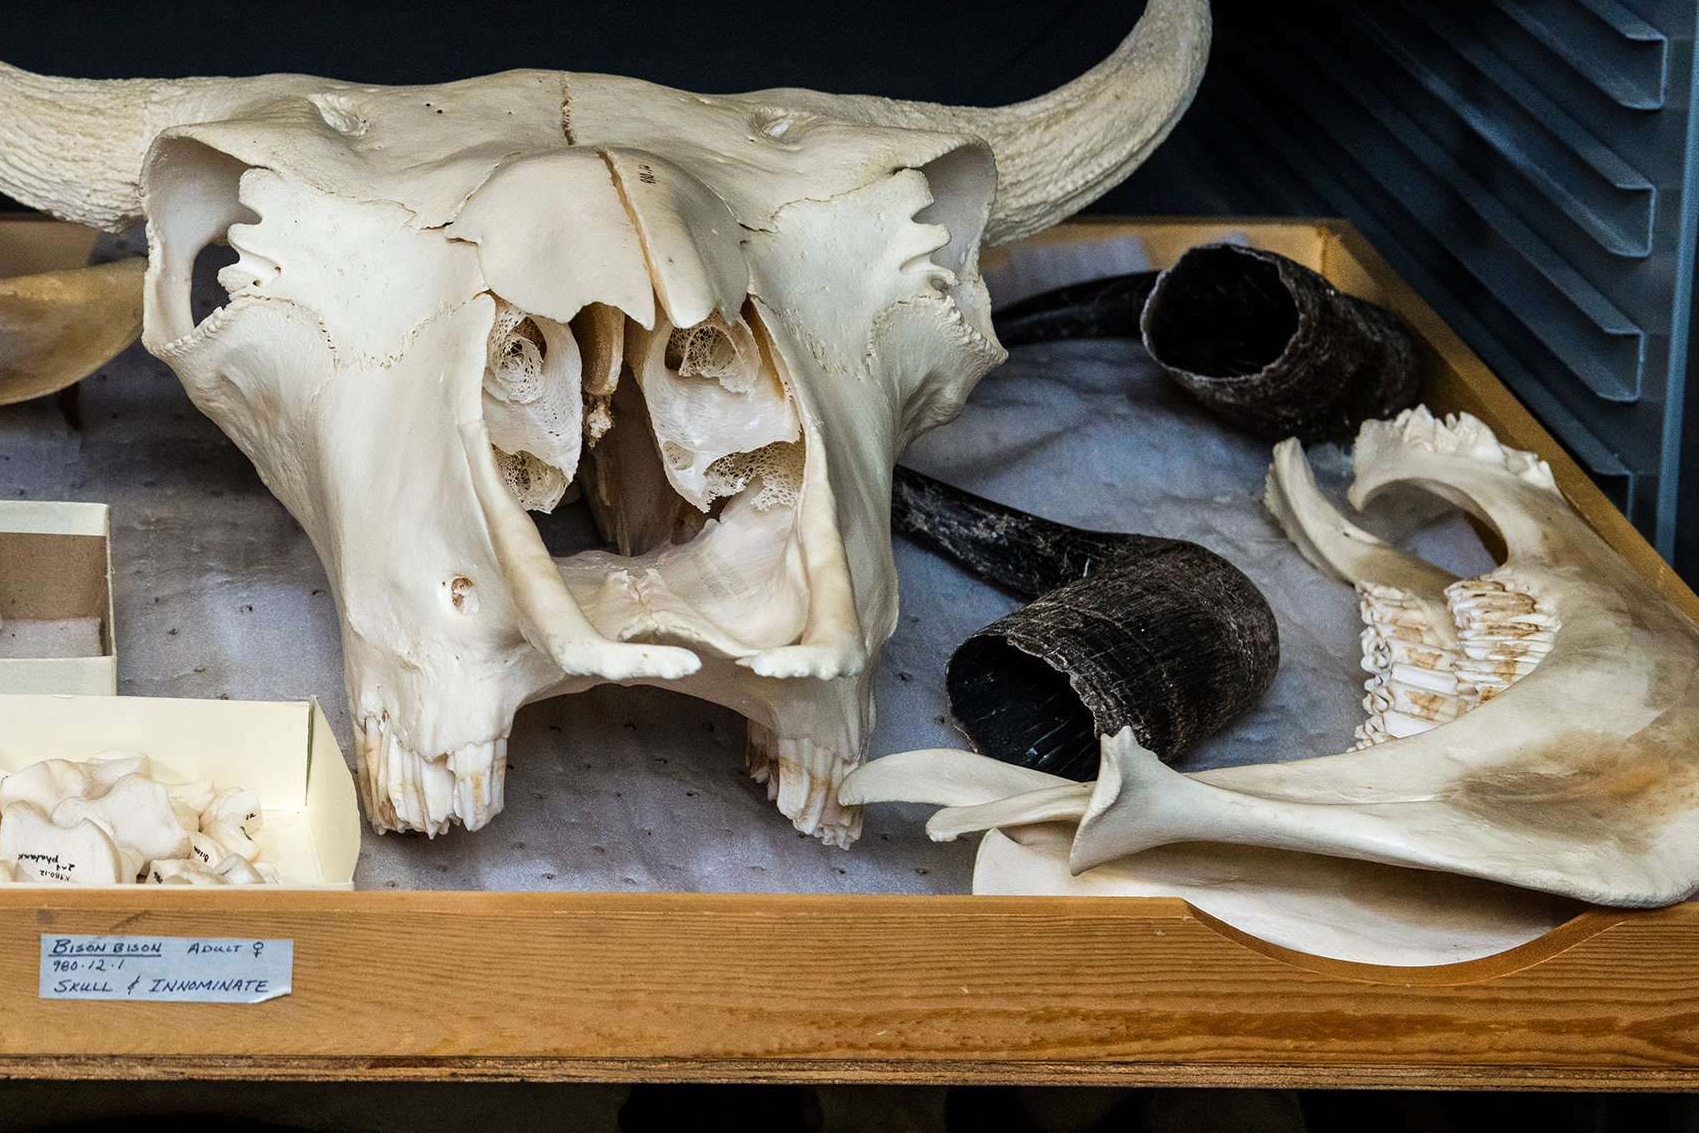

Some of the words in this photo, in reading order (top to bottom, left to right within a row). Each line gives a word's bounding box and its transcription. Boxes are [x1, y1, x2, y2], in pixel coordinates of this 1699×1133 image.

[52, 939, 107, 953] BISON
[113, 942, 162, 953] BISON
[187, 942, 243, 954] ADULT
[54, 979, 114, 993] SKULL
[149, 979, 269, 993] INNOMINATE
